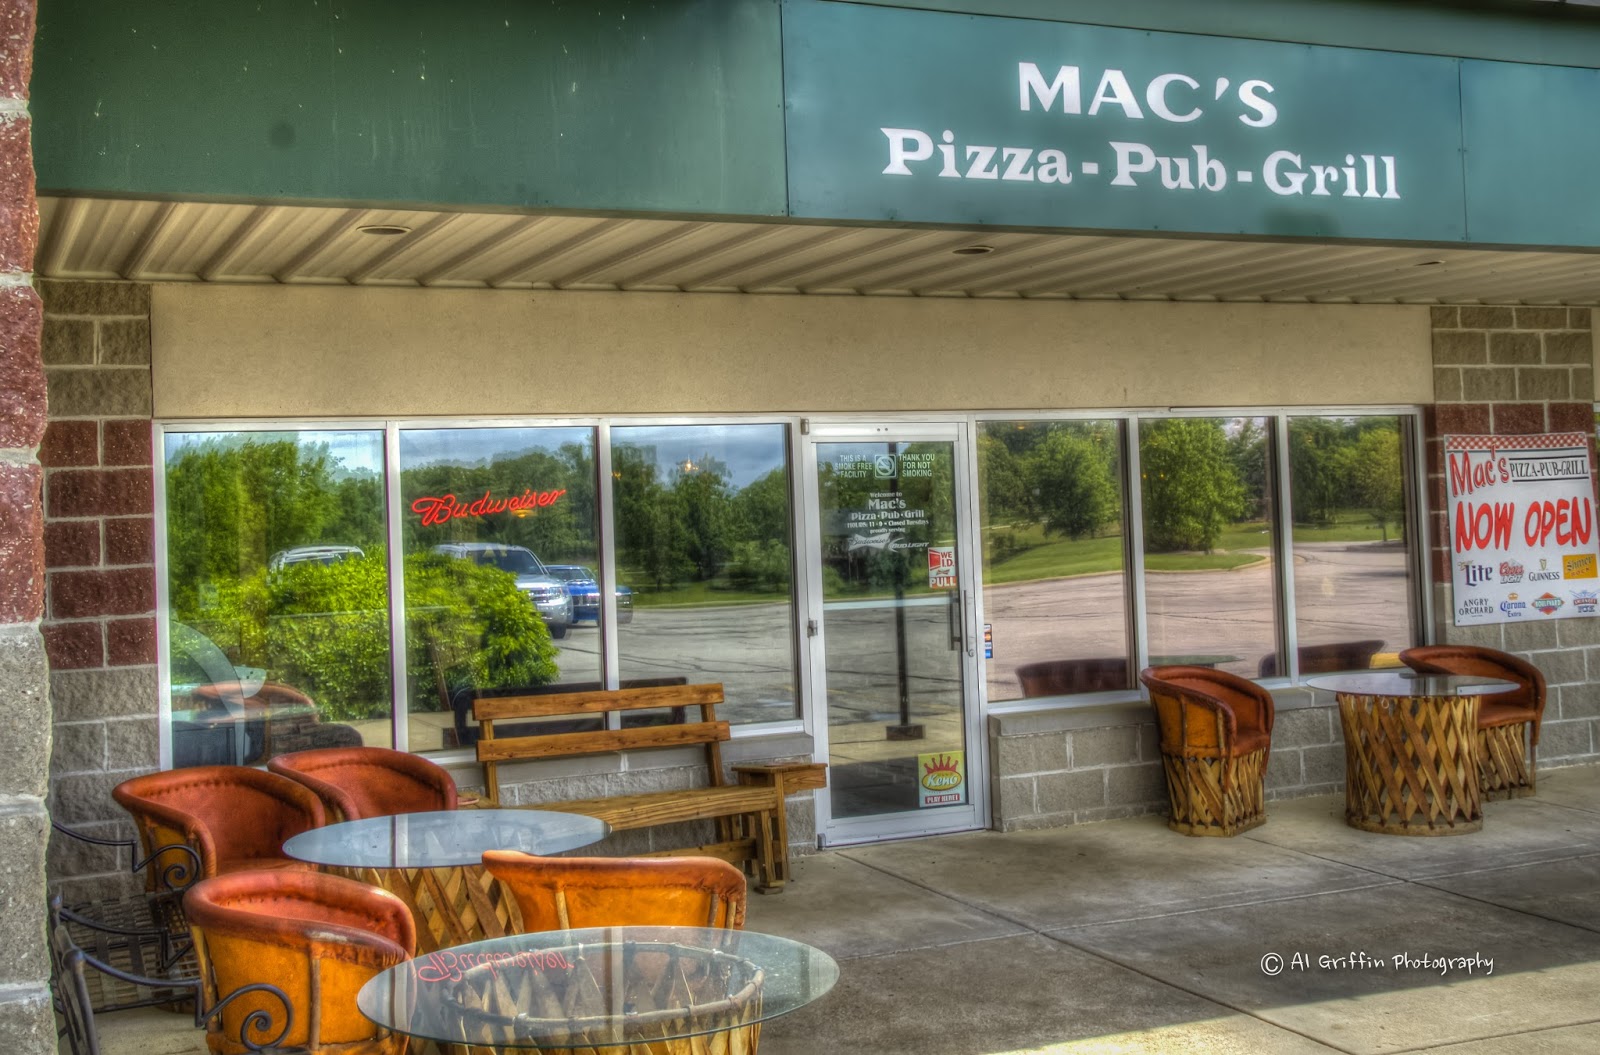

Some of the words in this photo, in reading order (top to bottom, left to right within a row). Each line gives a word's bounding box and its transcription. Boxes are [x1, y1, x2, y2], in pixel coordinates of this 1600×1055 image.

[1017, 61, 1279, 128] MAC'S
[854, 454, 861, 462] IS
[862, 454, 867, 462] A
[921, 453, 935, 461] YOU
[834, 462, 857, 470] SMOKE
[857, 462, 873, 470] FREE
[917, 461, 931, 469] NOT
[1449, 444, 1510, 497] Mac's
[840, 471, 867, 479] FACILITY
[411, 489, 567, 526] Budweiser
[868, 498, 907, 510] Mac's
[1456, 501, 1515, 554] NOW
[1524, 496, 1592, 548] OPEN
[1464, 564, 1493, 587] Lite
[1529, 572, 1560, 581] GUINNESS
[929, 576, 957, 589] PULL
[1464, 598, 1489, 608] ANGRY
[1500, 601, 1526, 612] Corona
[1459, 606, 1494, 616] ORCHARD
[927, 774, 958, 787] Keno
